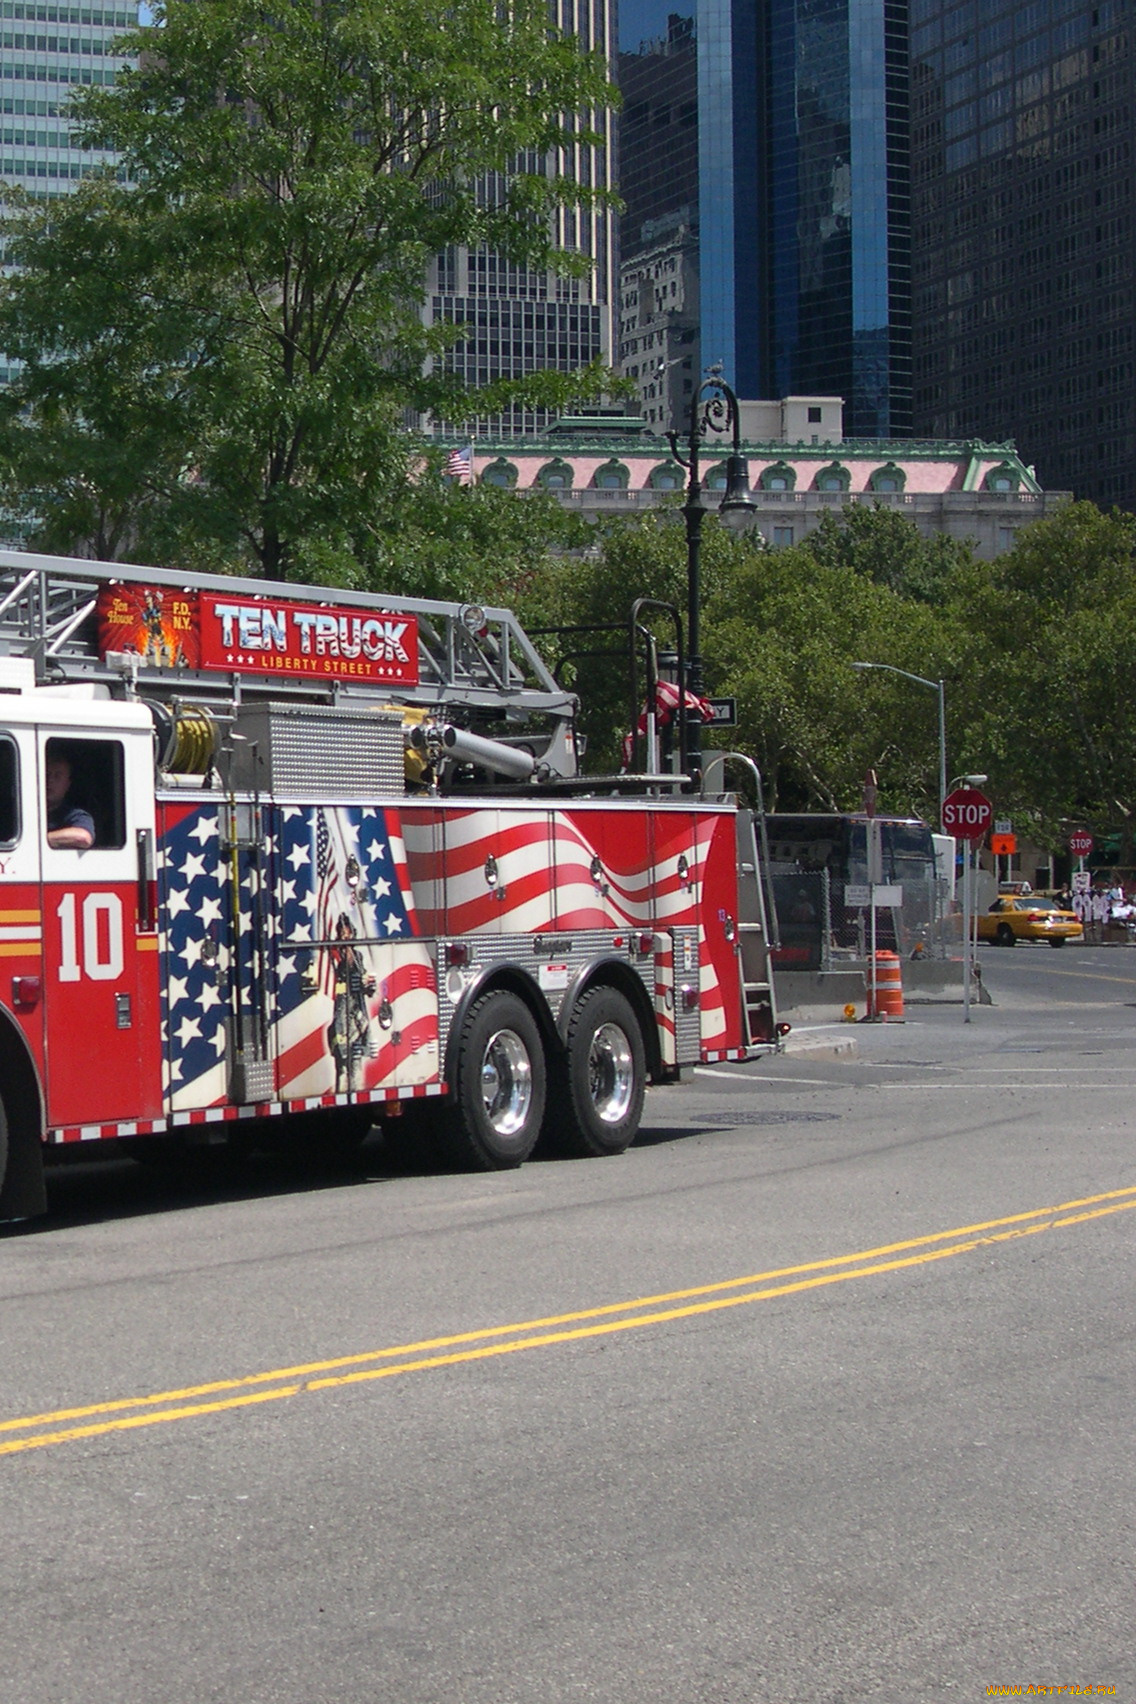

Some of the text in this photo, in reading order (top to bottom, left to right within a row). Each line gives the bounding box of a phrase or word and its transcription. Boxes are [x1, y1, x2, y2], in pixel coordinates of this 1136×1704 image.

[172, 602, 191, 616] F.D.
[172, 616, 192, 630] N.Y.
[214, 603, 410, 663] TEN TRUCK
[261, 655, 372, 675] LIBERTY STREET
[944, 804, 990, 824] STOP
[1070, 838, 1092, 850] STOP
[57, 892, 124, 982] 10
